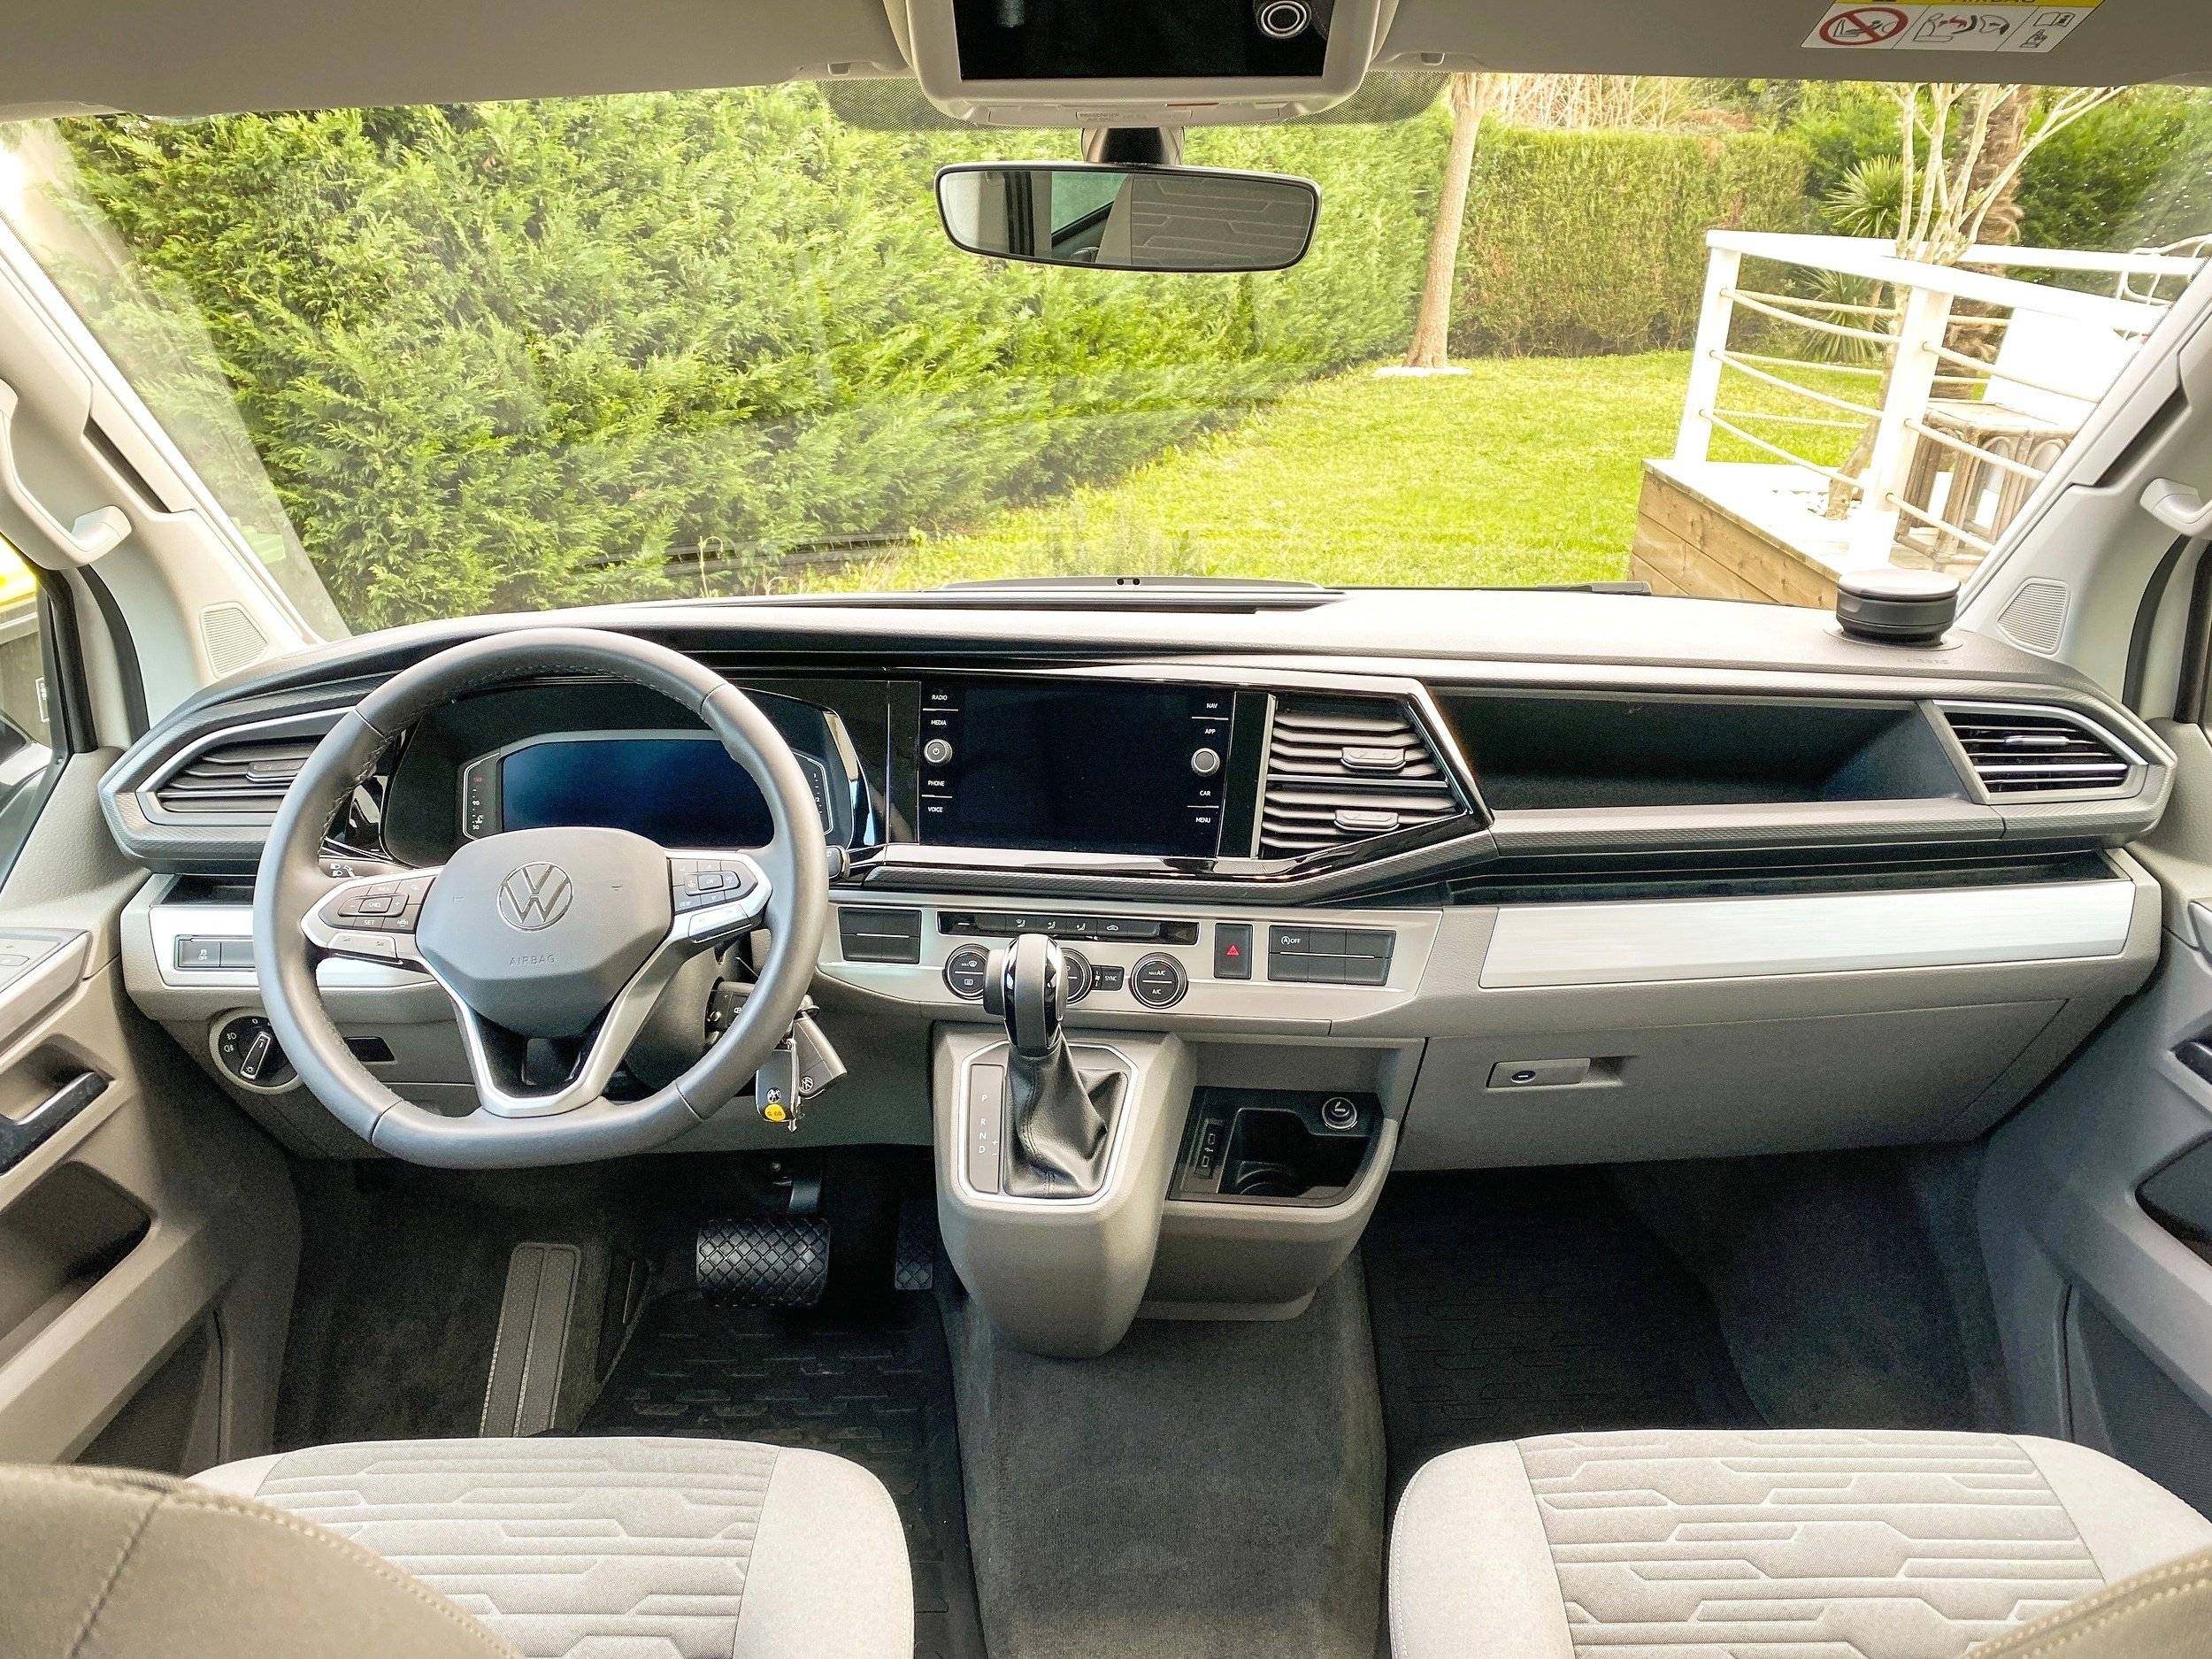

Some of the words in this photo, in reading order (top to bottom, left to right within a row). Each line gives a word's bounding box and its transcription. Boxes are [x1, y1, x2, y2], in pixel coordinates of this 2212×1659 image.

[509, 954, 555, 966] AIRBAG
[981, 1094, 987, 1102] P
[980, 1118, 987, 1126] R
[979, 1132, 987, 1141] N
[979, 1145, 986, 1154] D
